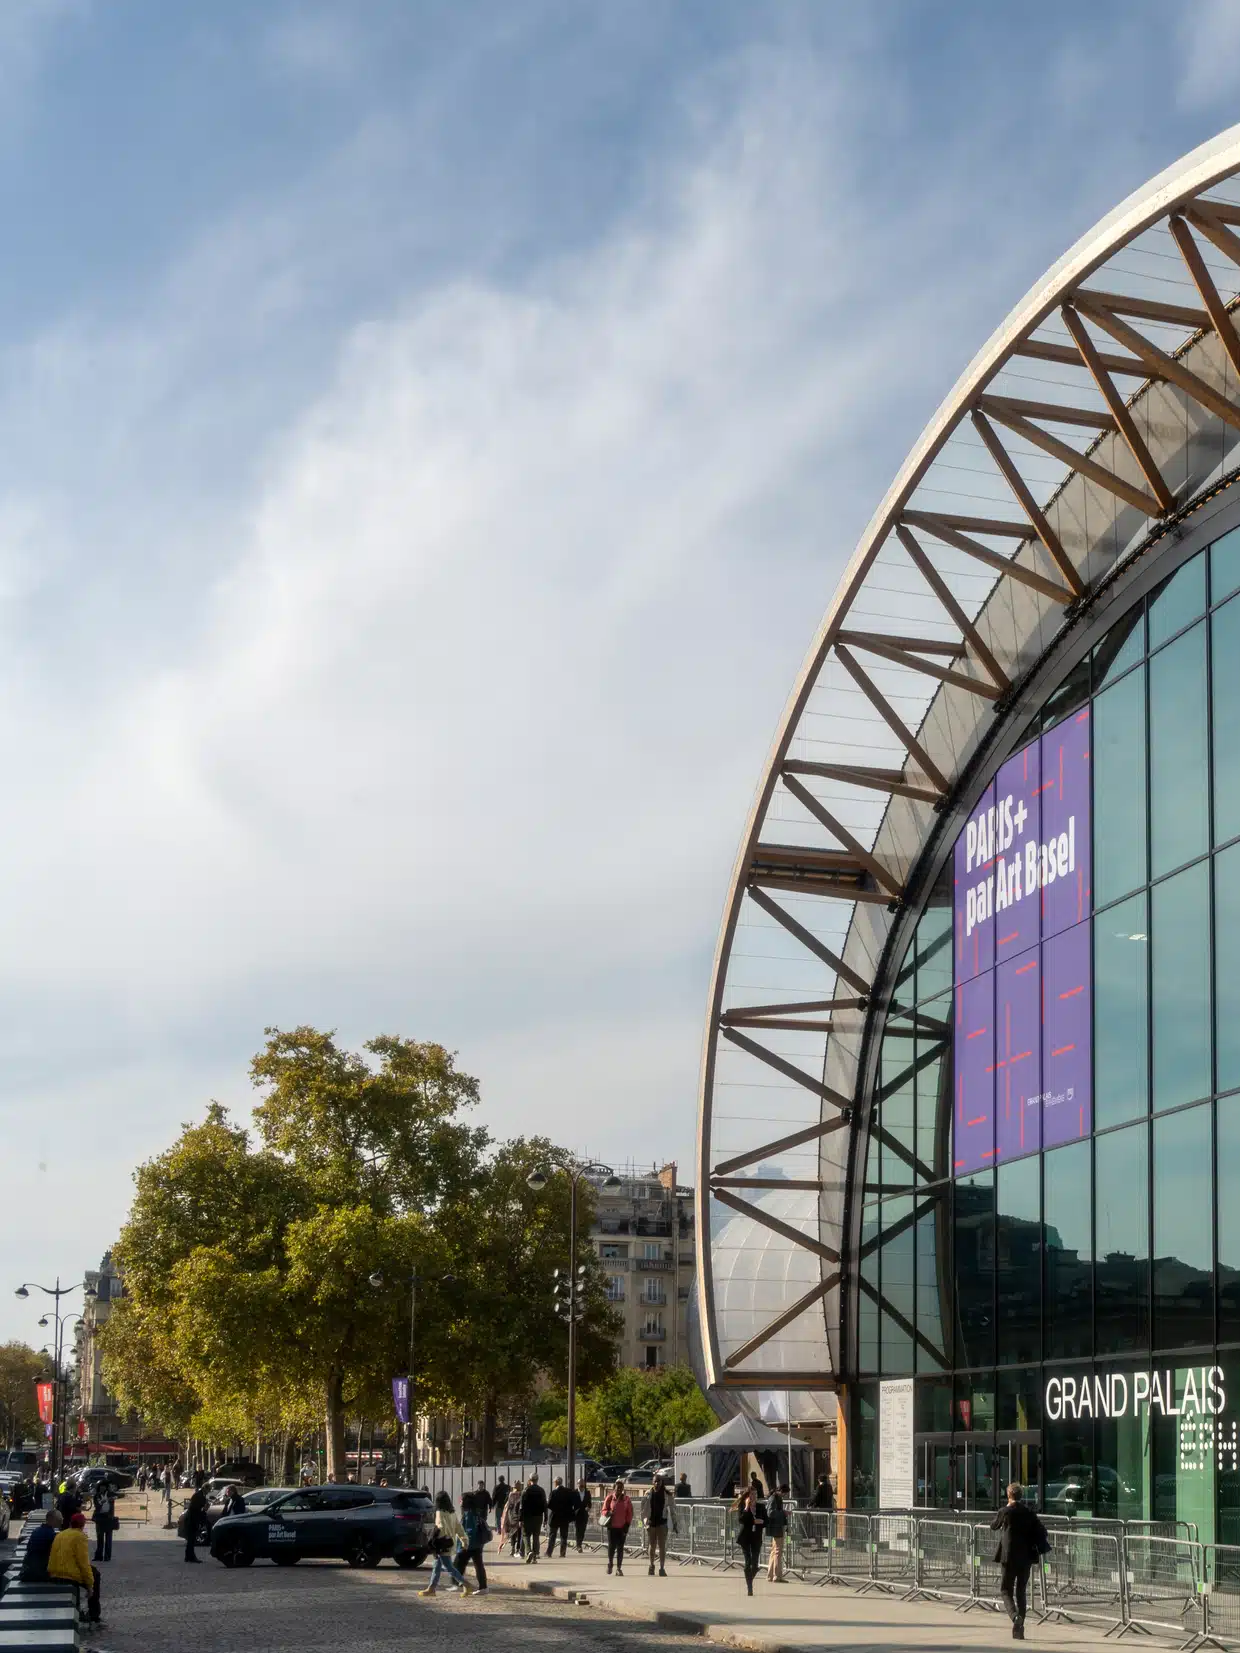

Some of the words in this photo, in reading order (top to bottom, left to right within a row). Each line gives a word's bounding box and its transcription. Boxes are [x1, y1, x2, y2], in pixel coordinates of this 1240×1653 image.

[966, 794, 1028, 874] PARIS+
[966, 874, 994, 937] par
[995, 851, 1022, 913] Art
[1025, 815, 1075, 896] Basel
[1045, 1373, 1128, 1420] GRAND
[1133, 1366, 1226, 1417] PALAIS
